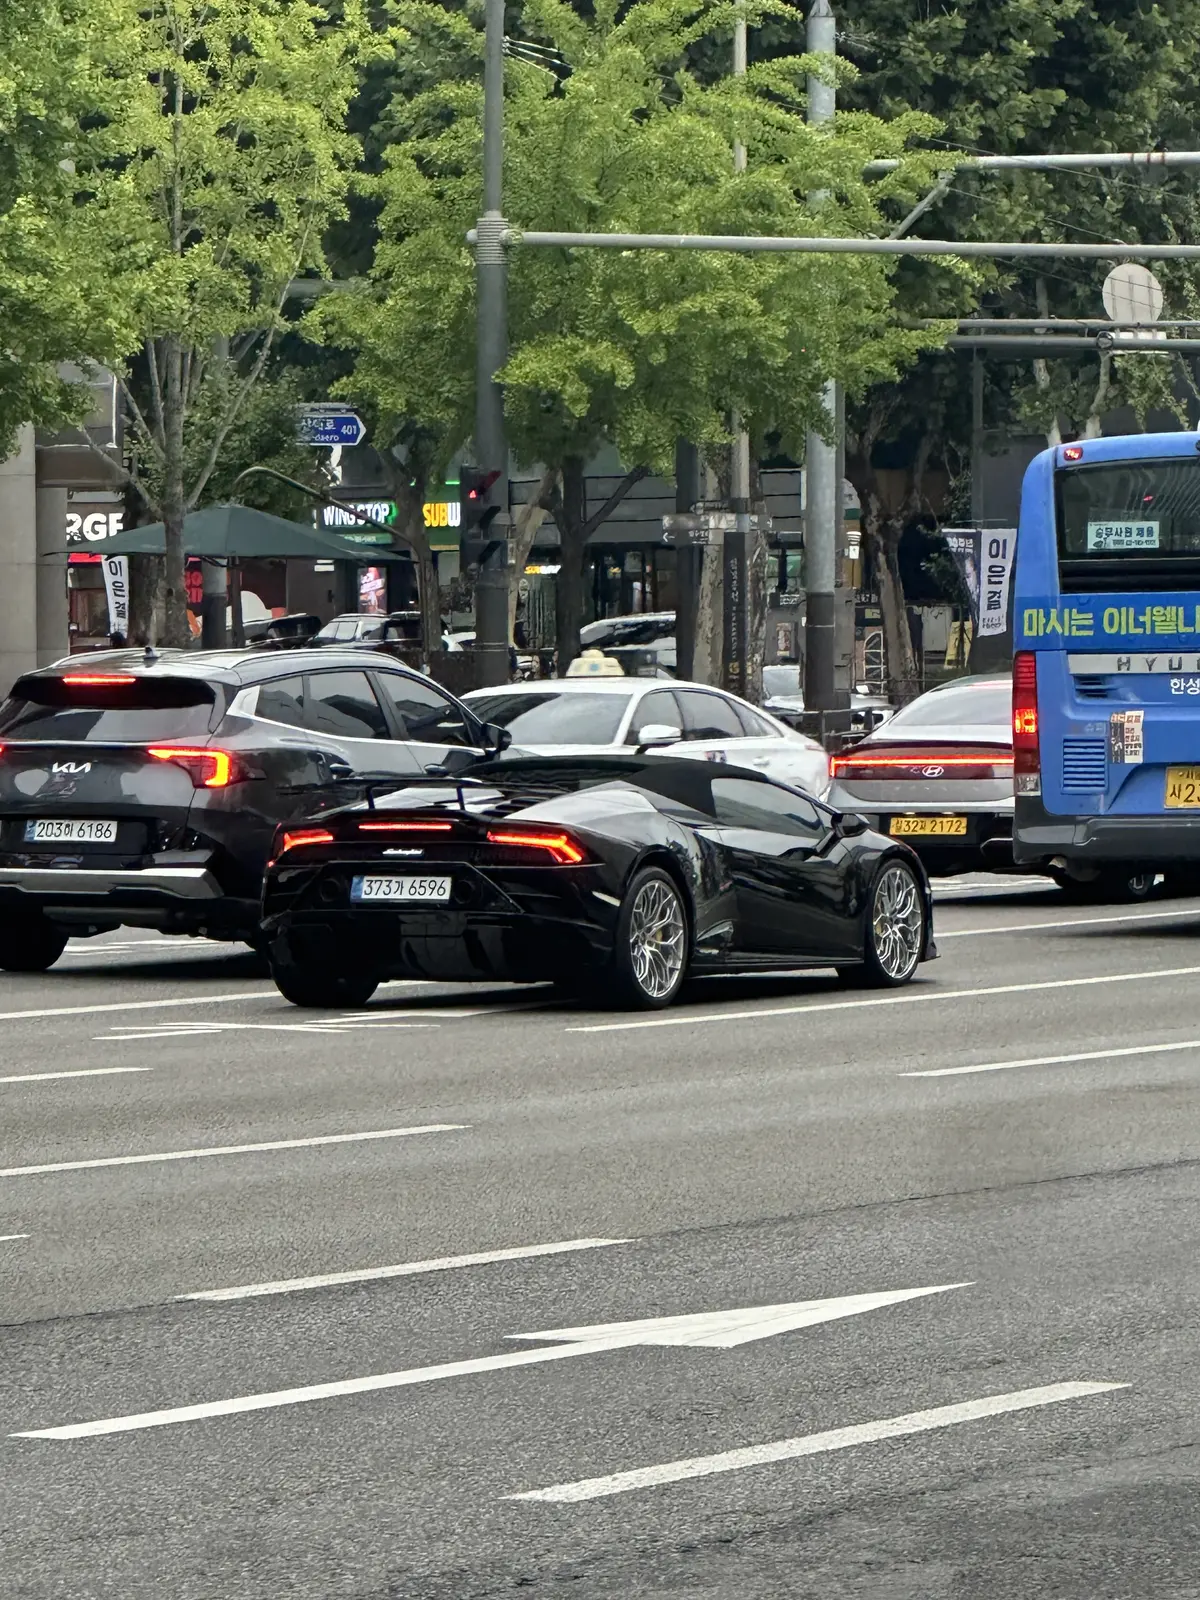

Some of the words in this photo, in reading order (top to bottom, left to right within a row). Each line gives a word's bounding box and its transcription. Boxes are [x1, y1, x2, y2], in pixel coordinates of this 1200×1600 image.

[341, 424, 357, 435] 401
[1023, 607, 1094, 637] 마시는
[1116, 656, 1200, 672] HYU
[77, 822, 113, 839] 6186
[929, 819, 963, 833] 2172
[364, 879, 404, 896] 373가
[408, 879, 446, 897] 6596
